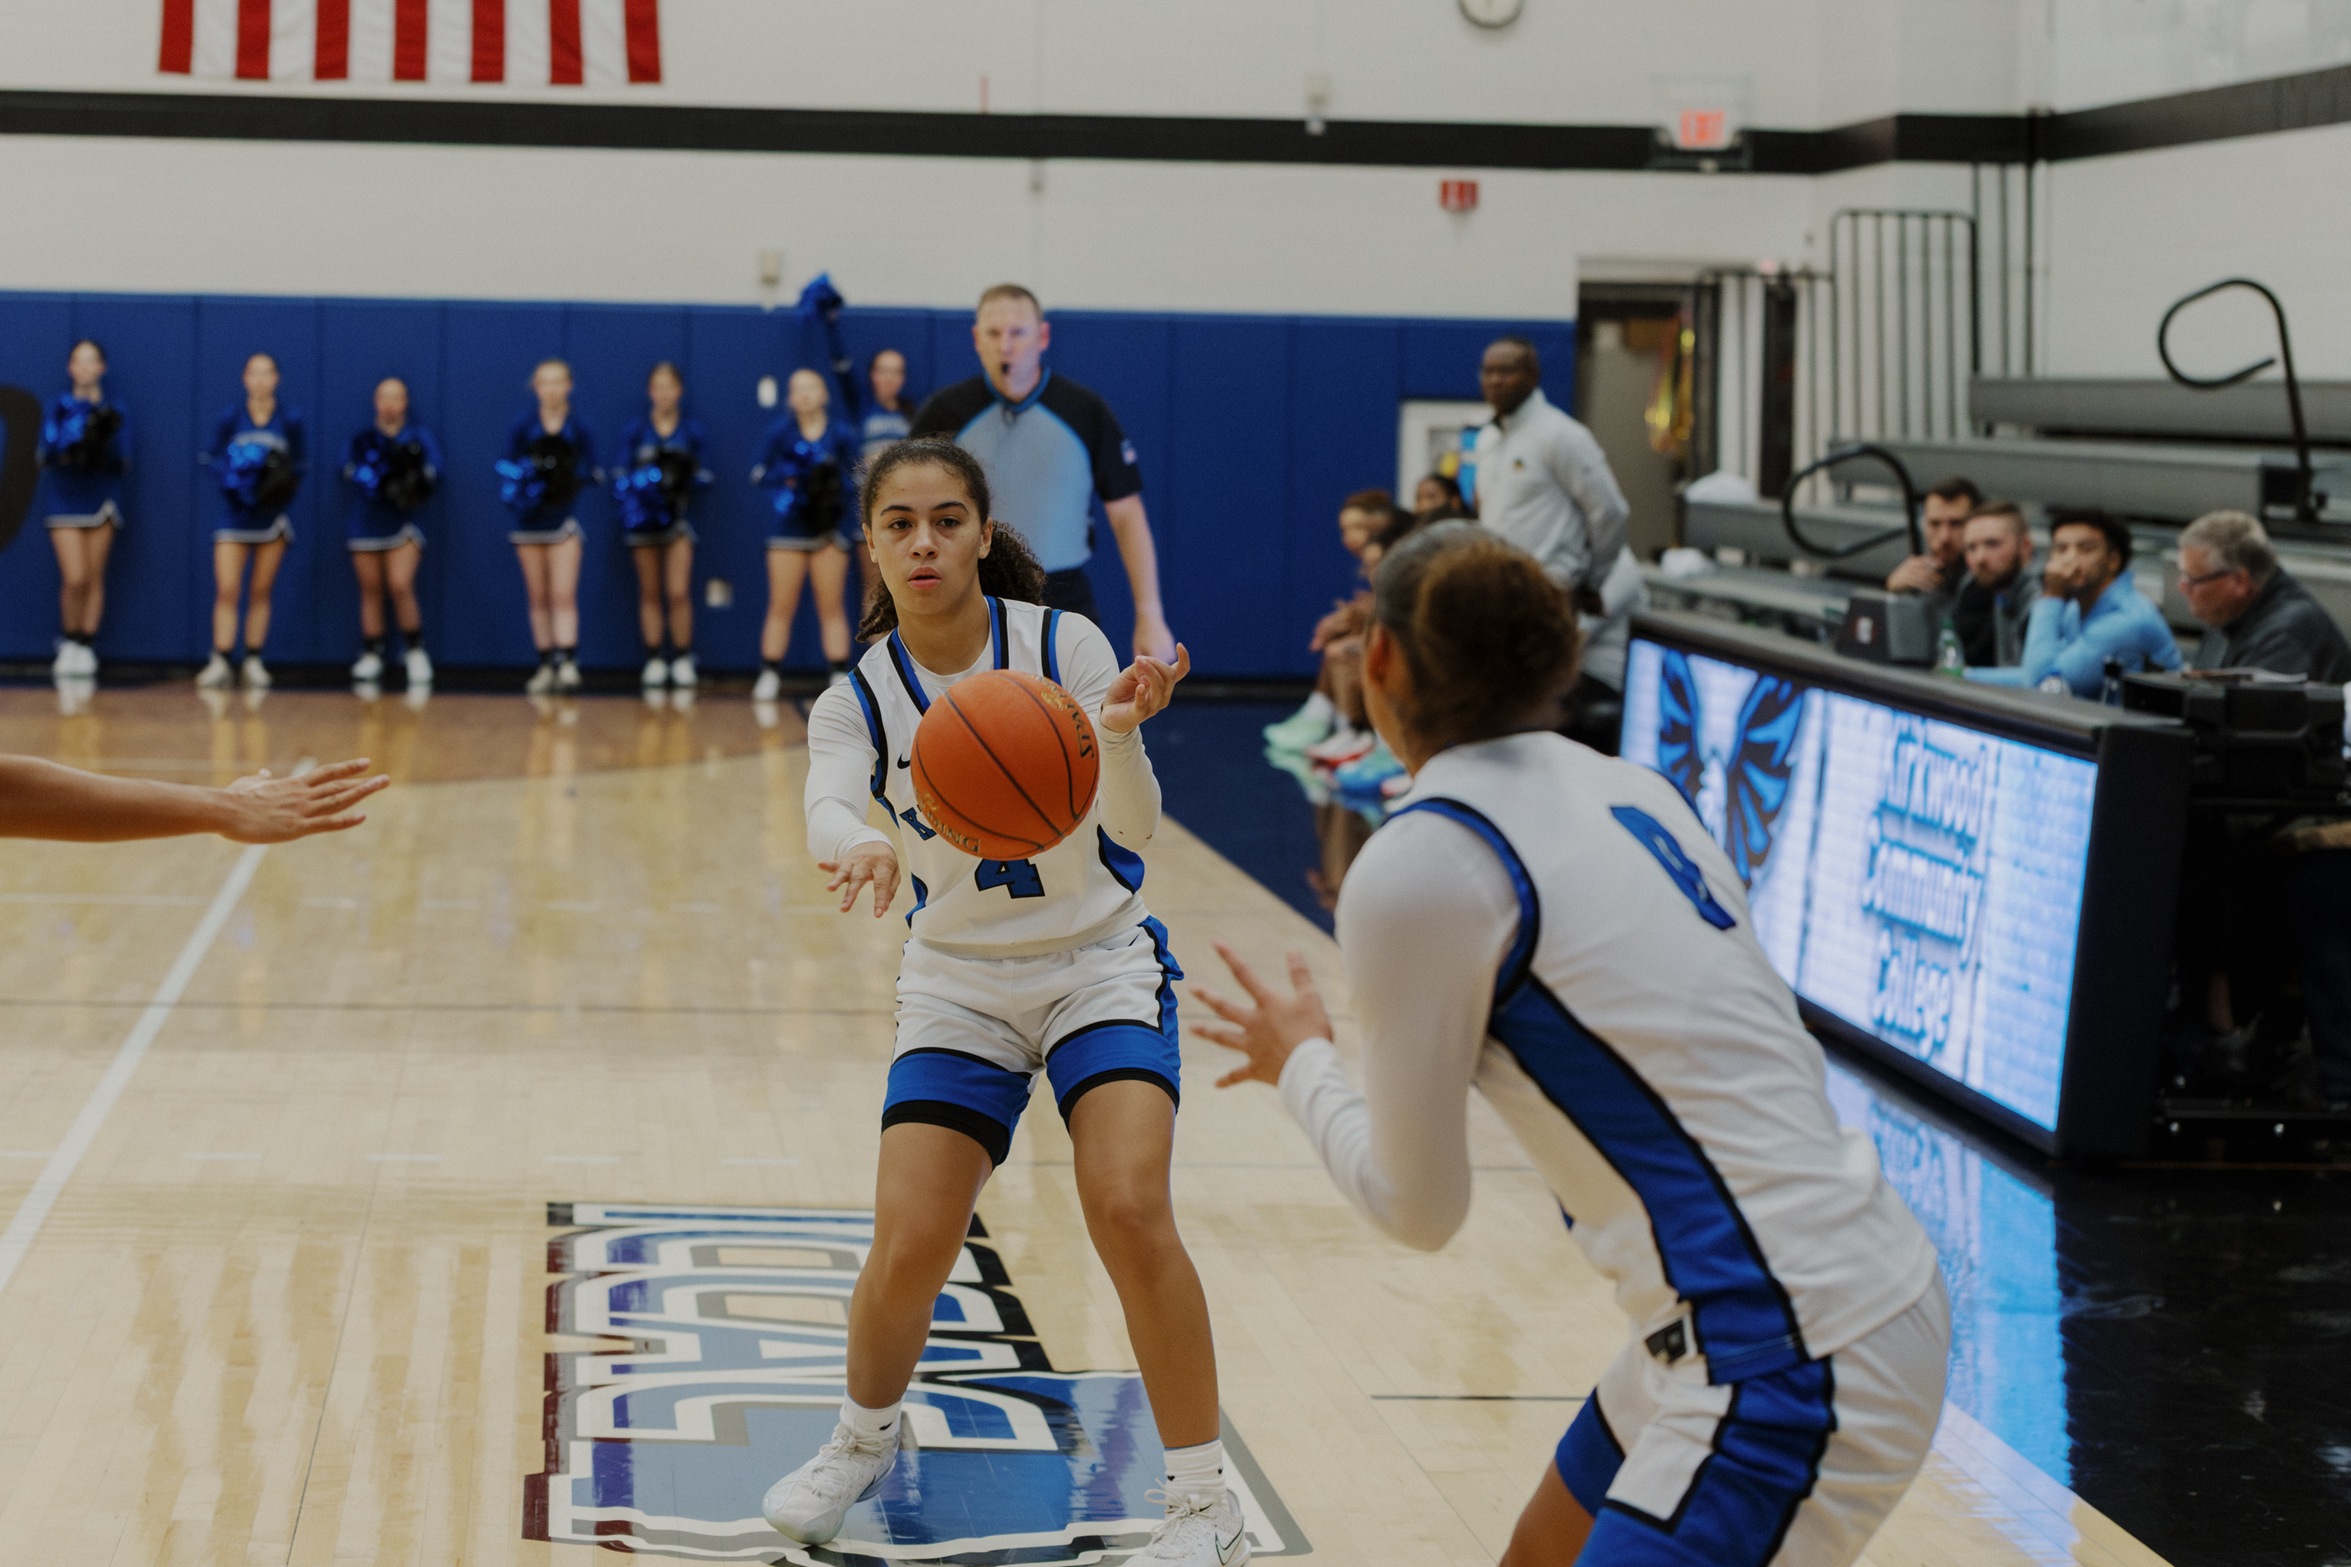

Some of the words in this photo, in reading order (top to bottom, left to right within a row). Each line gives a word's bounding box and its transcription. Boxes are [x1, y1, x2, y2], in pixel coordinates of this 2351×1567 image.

[974, 857, 1046, 899] 4
[1861, 808, 1984, 970] Community
[1872, 922, 1951, 1062] College
